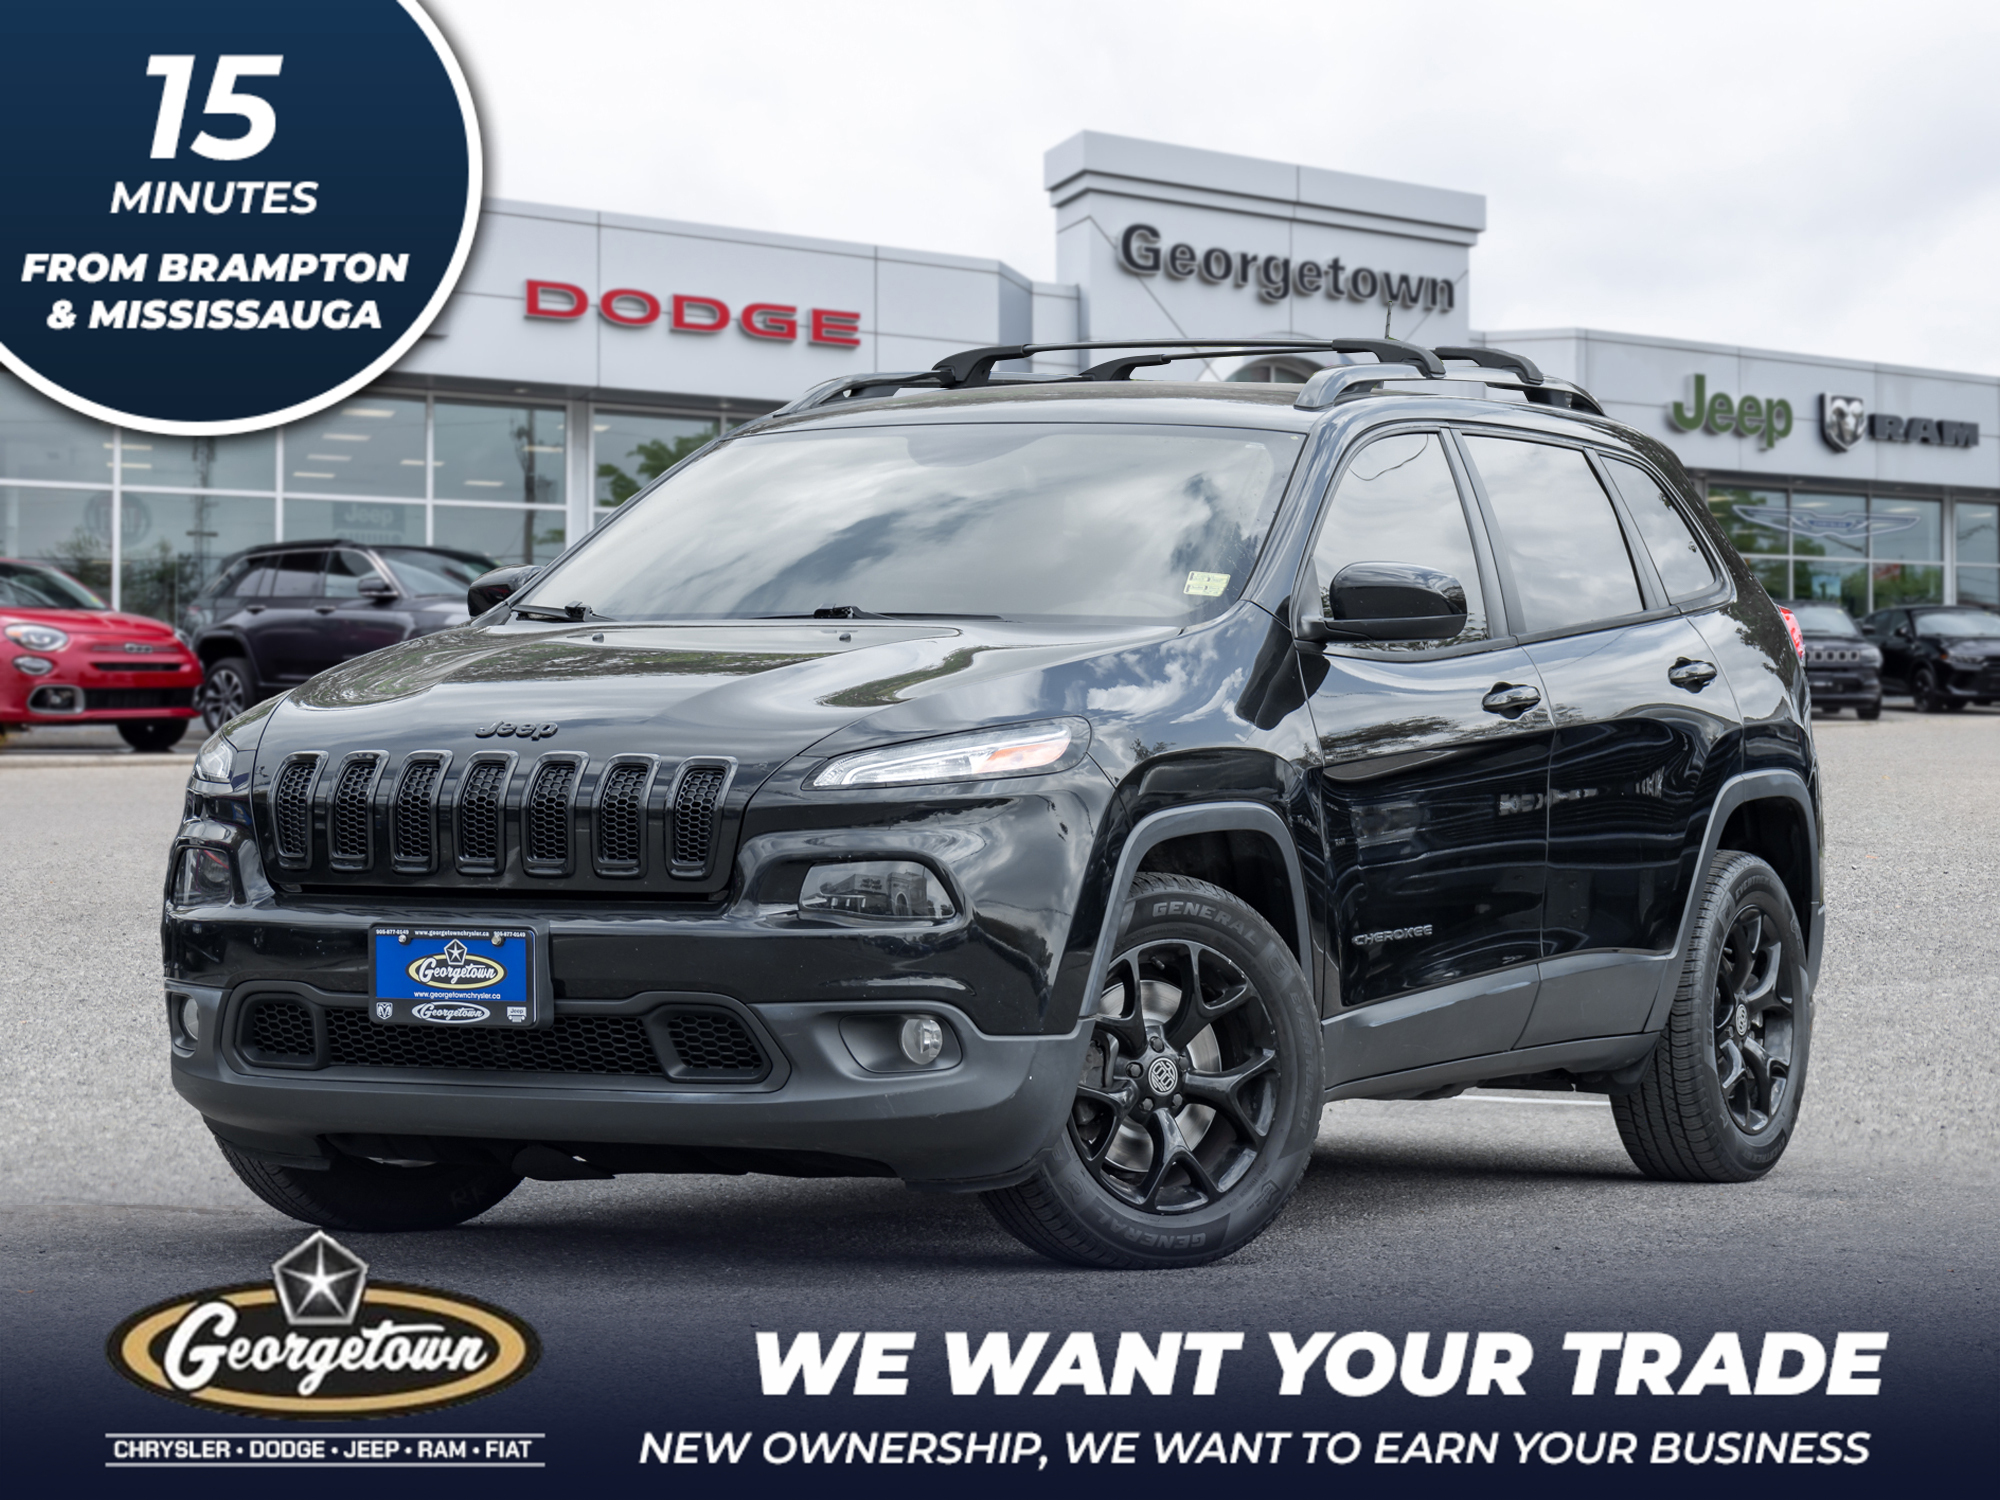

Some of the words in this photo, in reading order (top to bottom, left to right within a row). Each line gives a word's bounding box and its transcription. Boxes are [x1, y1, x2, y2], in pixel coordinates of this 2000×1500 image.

[1118, 224, 1455, 312] Georgetown
[524, 279, 861, 348] DODGE
[1669, 374, 1793, 450] Jeep
[1868, 413, 1980, 448] RAM
[344, 503, 394, 527] Jeep
[475, 720, 558, 741] Jeep
[414, 929, 490, 937] www.georgetownchrysler.ca
[1152, 901, 1257, 945] GENERAL
[1352, 924, 1433, 945] CHEROKEE
[418, 957, 496, 984] Georgetown
[413, 991, 501, 1000] www.georgetownchrysler.ca
[420, 1003, 484, 1021] Georgetown
[1097, 1208, 1206, 1249] GENERAL
